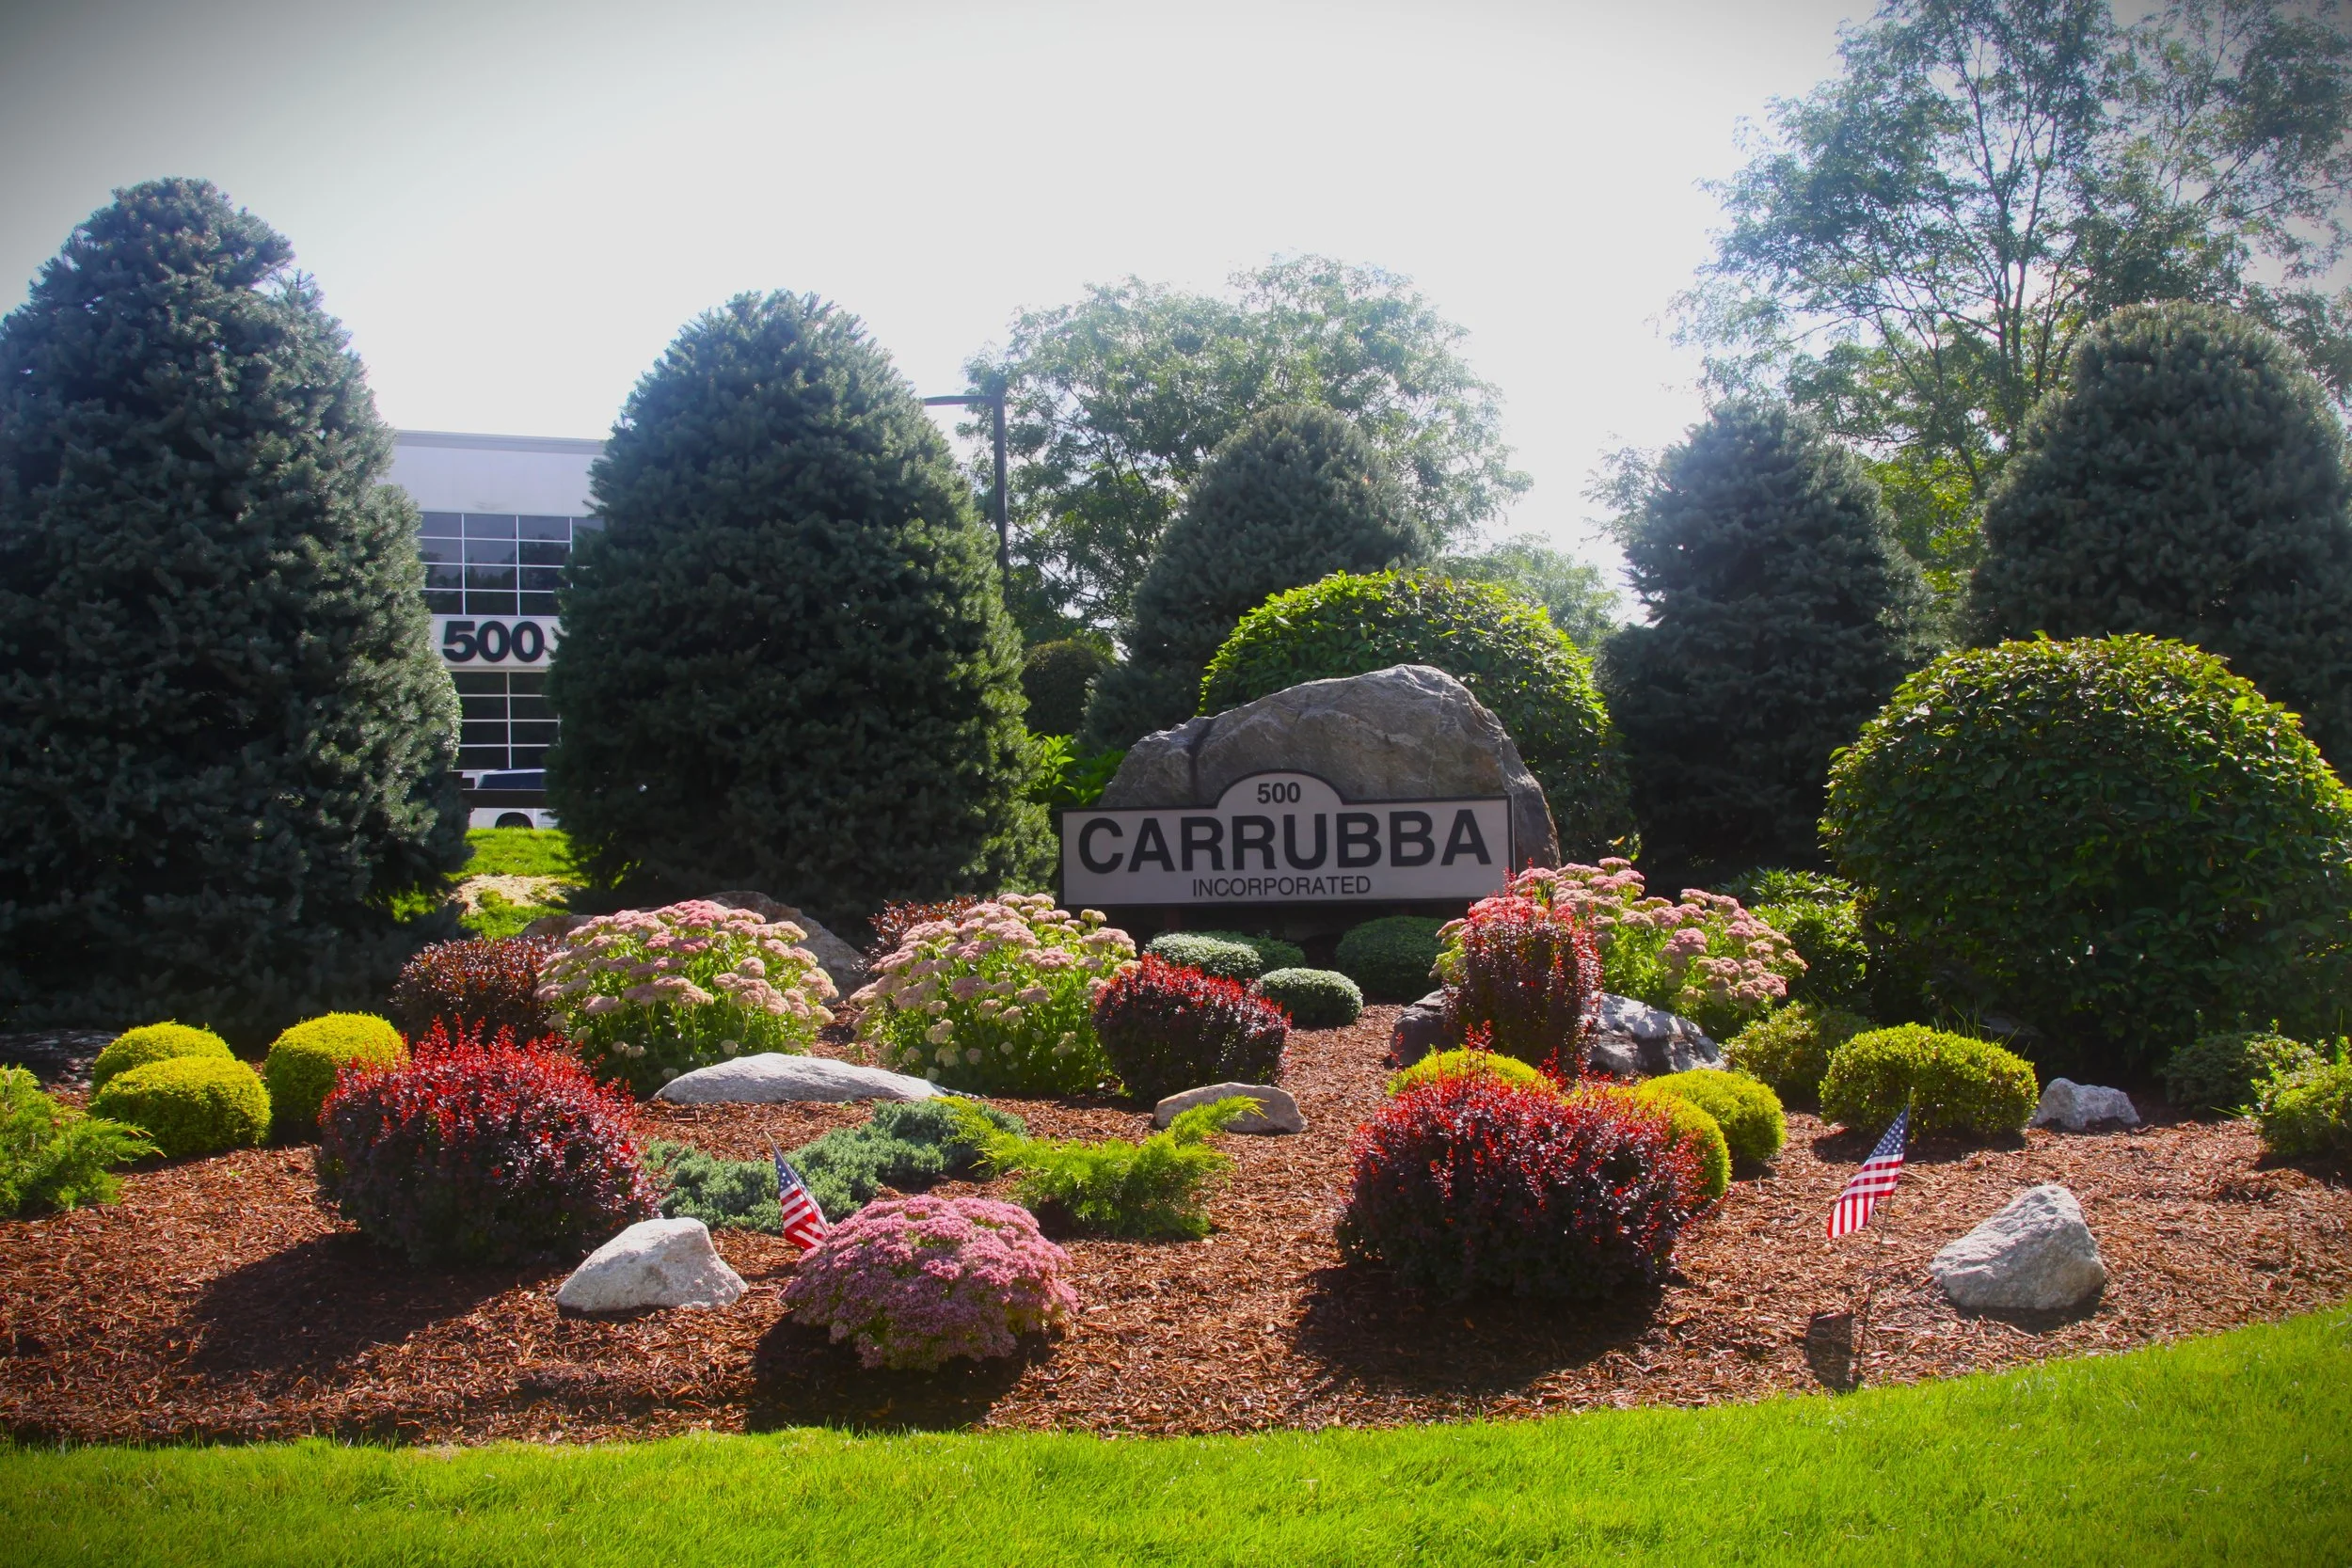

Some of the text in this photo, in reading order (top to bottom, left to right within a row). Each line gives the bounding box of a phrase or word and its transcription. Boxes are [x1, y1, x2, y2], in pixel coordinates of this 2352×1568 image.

[442, 621, 545, 662] 500
[1257, 782, 1301, 804] 500
[1078, 809, 1492, 874] CARRUBBA
[1193, 876, 1371, 897] INCORPORATED
